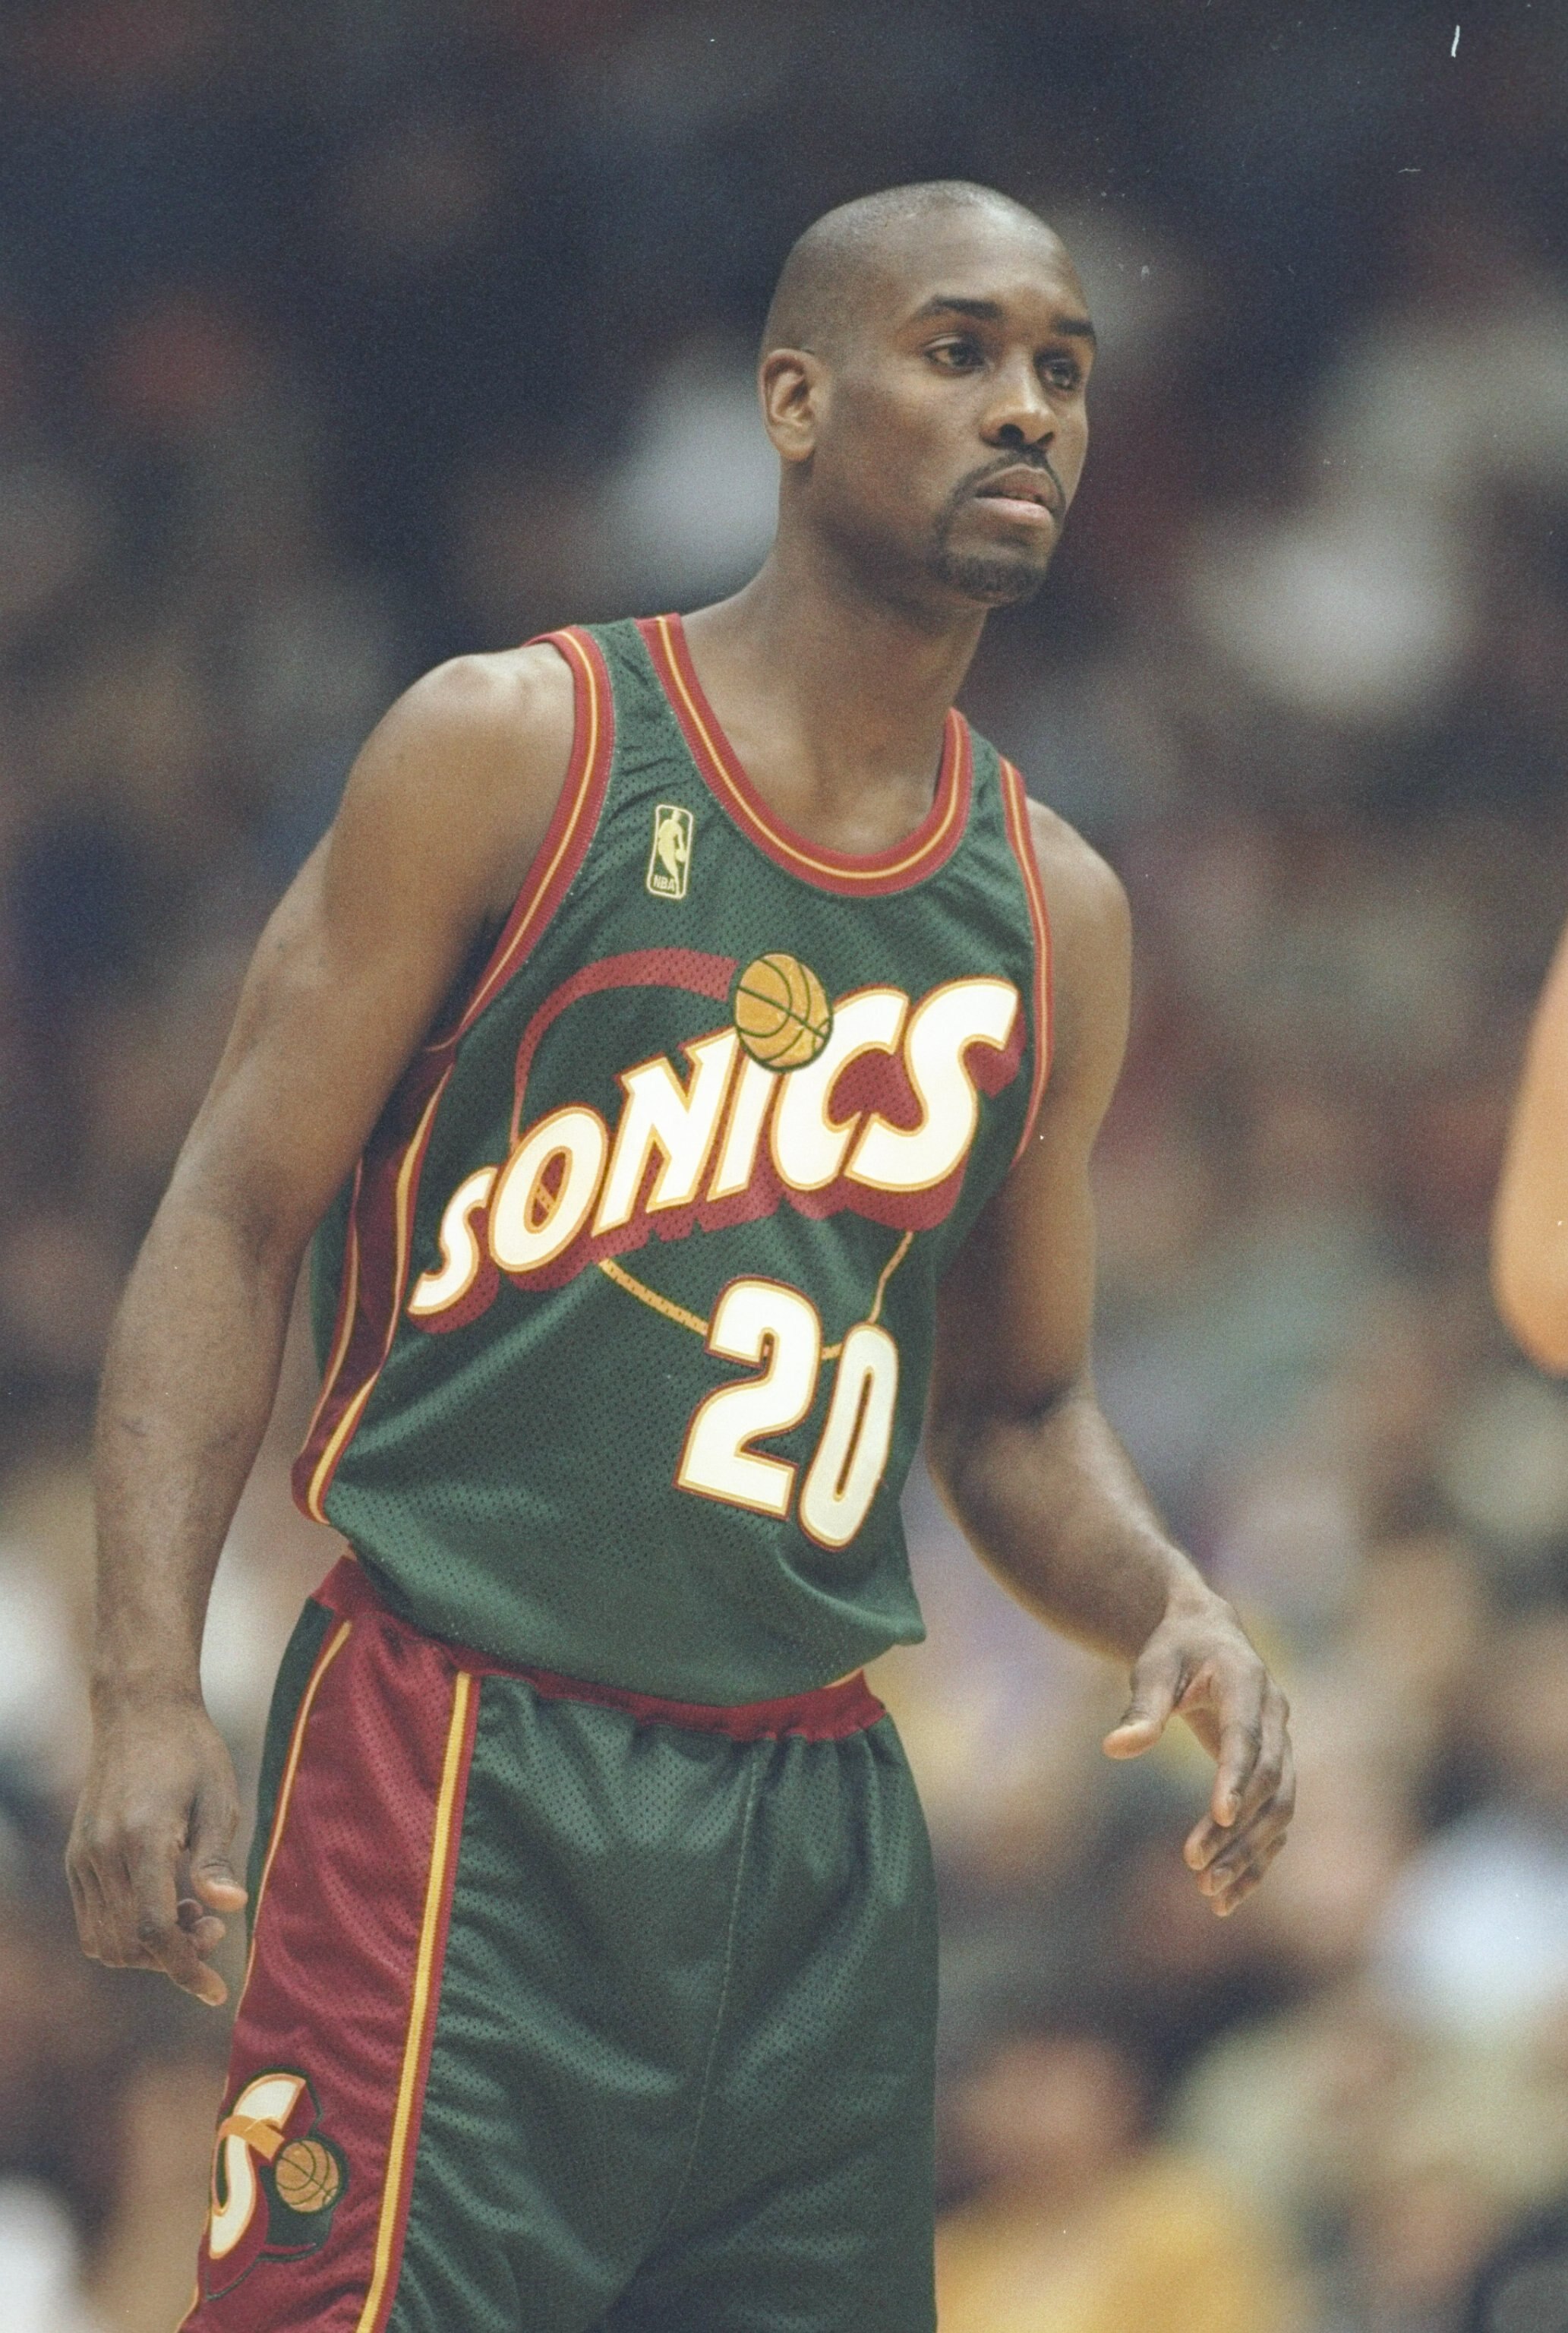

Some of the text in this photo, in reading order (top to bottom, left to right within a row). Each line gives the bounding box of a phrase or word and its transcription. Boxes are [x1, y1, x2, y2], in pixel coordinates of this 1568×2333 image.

[654, 875, 675, 892] NBA
[406, 974, 1021, 1318] SONICS
[672, 1274, 899, 1551] 20
